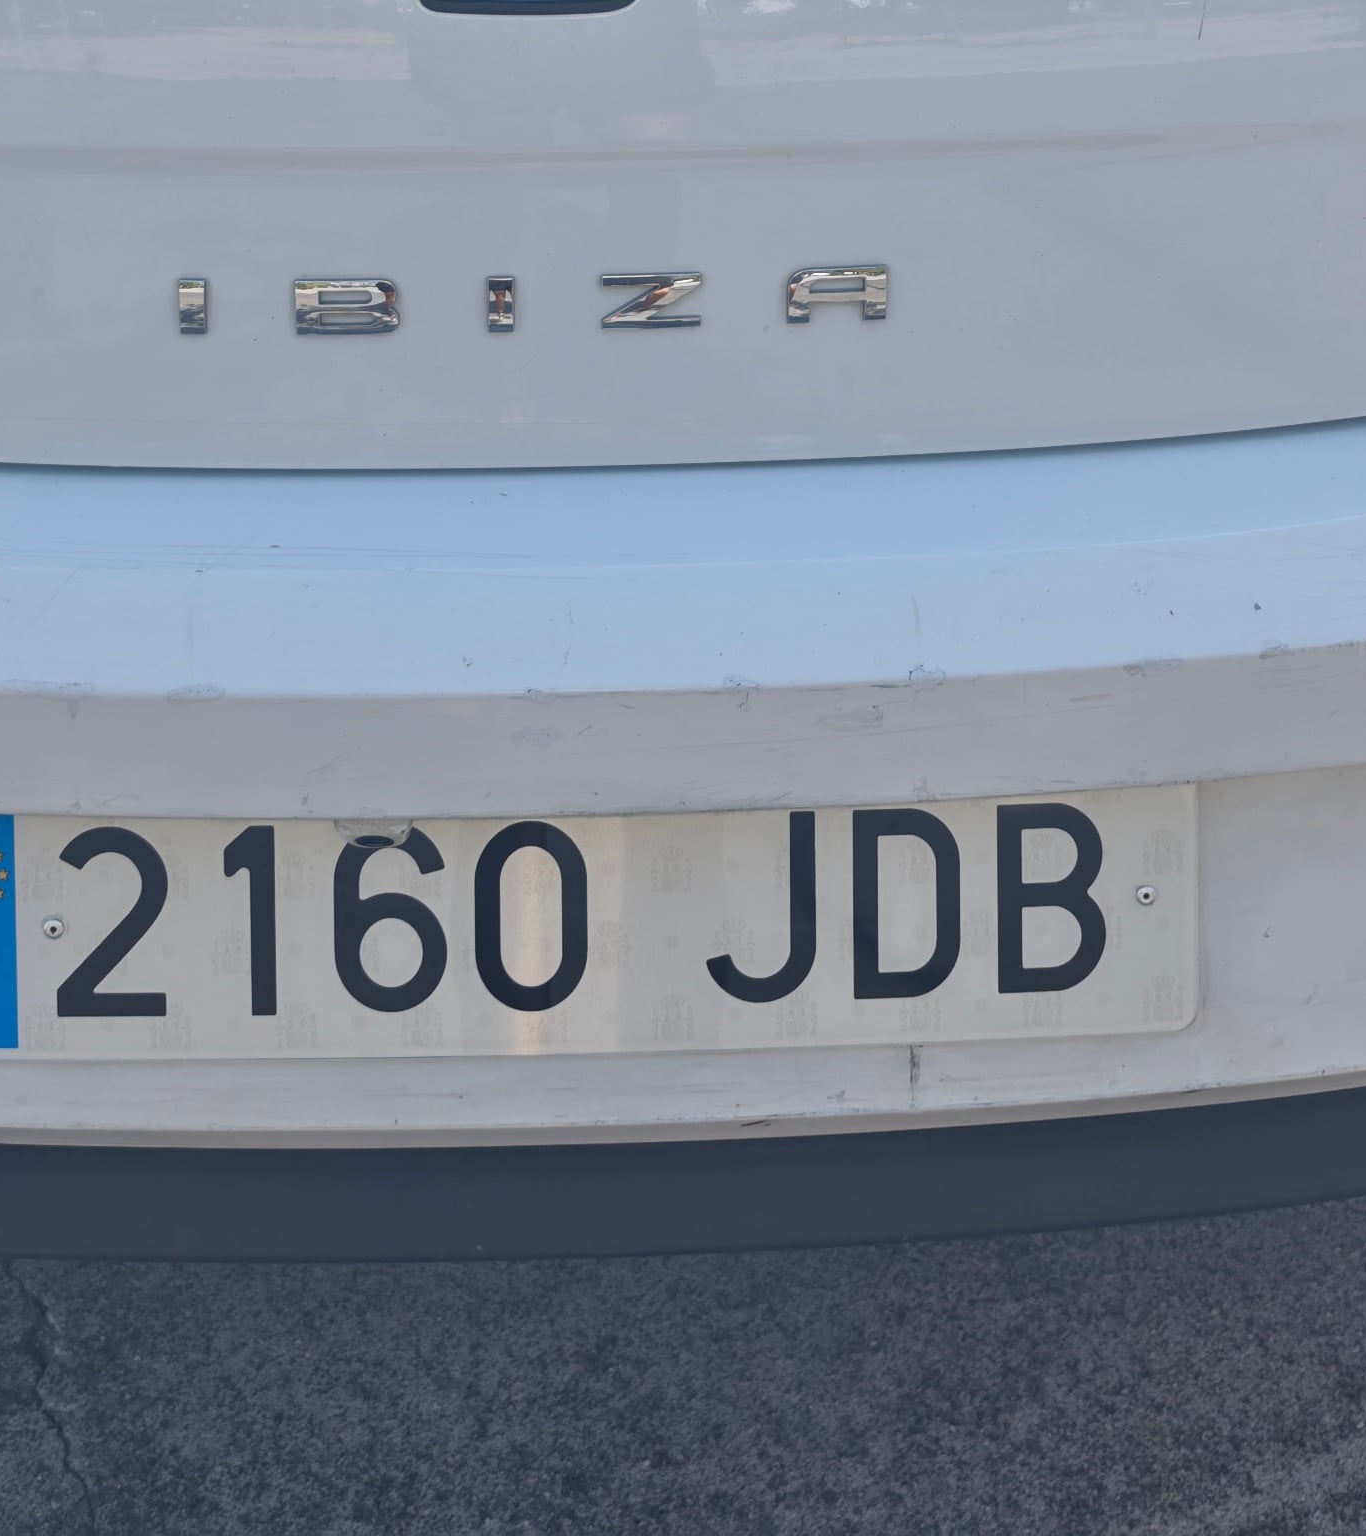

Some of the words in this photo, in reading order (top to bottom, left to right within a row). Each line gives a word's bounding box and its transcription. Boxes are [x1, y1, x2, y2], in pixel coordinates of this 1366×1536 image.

[178, 265, 889, 335] IBIZA
[57, 821, 588, 1017] 2160
[706, 803, 1107, 1003] JDB
